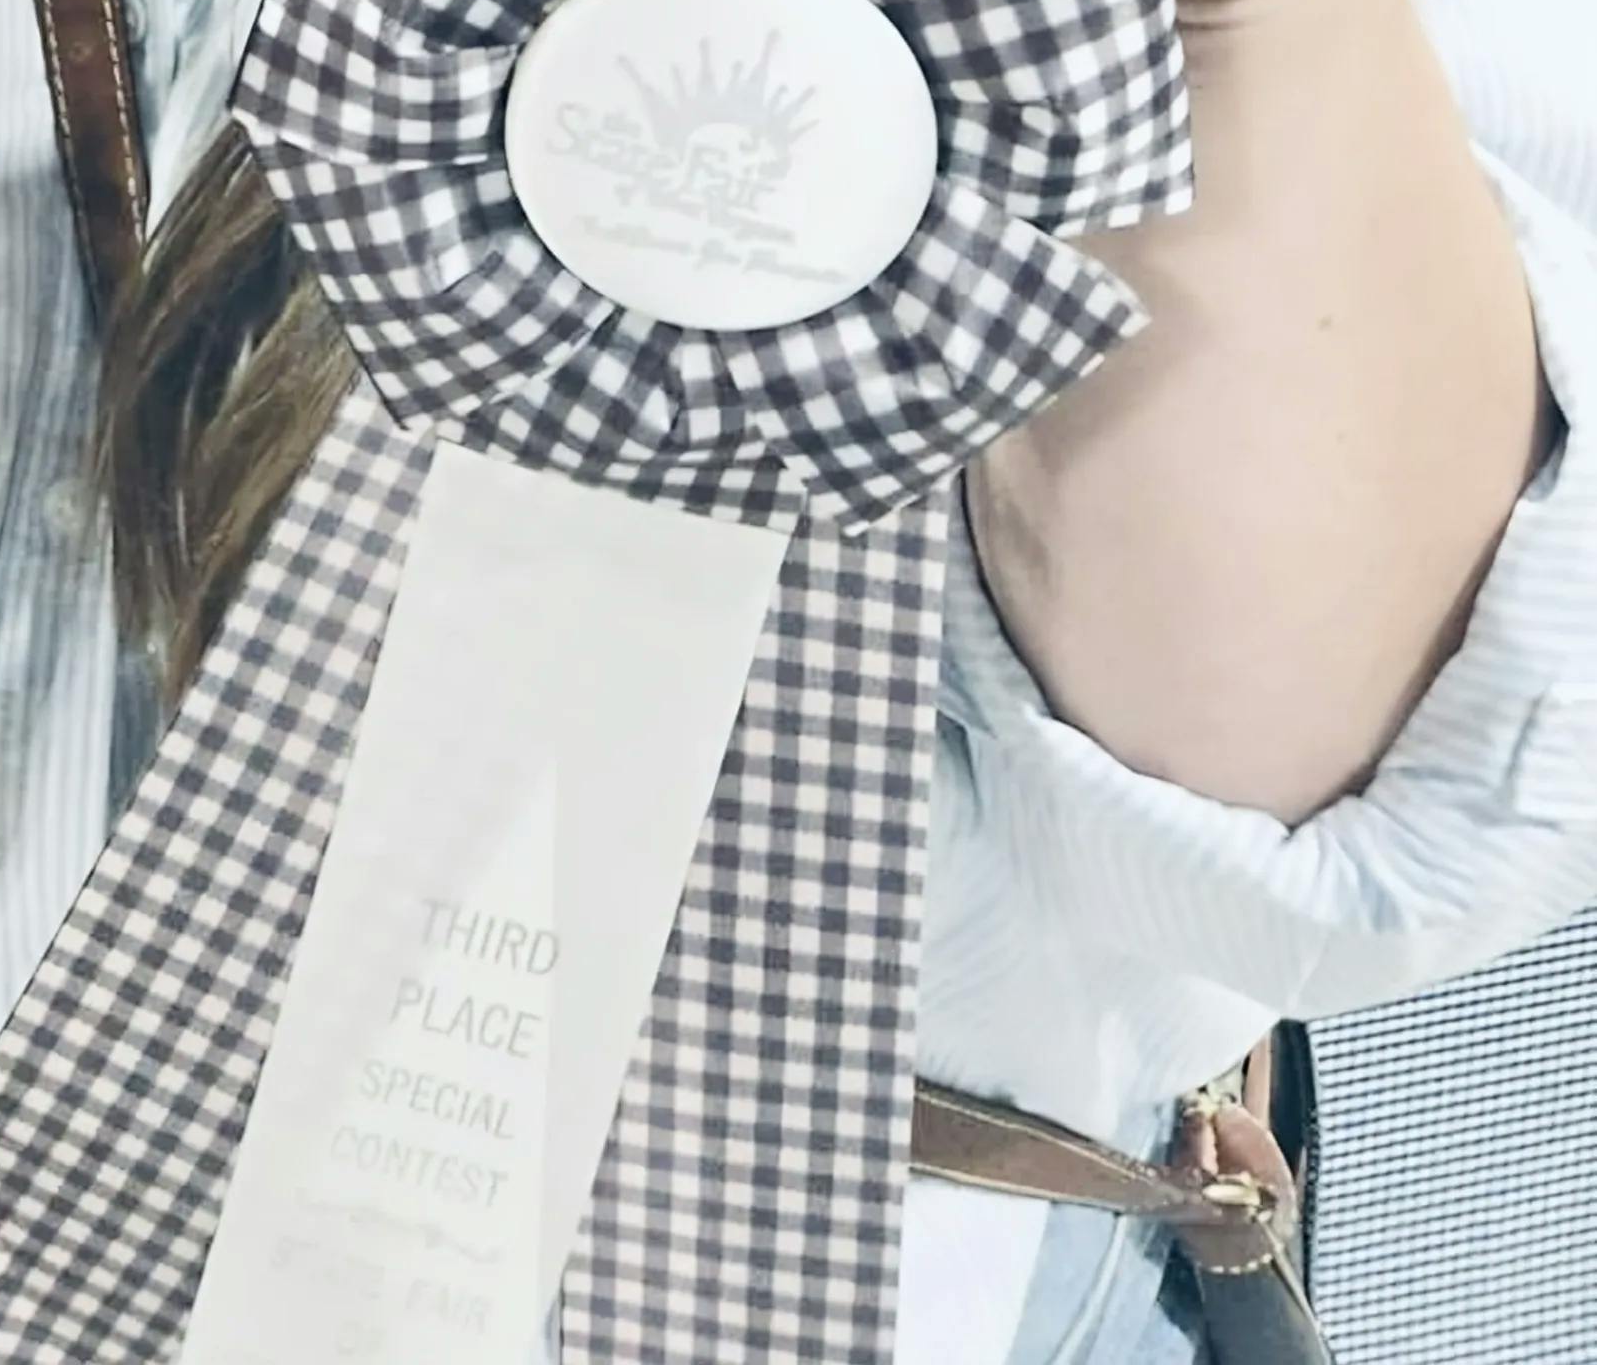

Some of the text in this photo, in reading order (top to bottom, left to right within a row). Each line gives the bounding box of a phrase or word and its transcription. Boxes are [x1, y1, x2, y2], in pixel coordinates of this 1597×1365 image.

[419, 898, 561, 976] THIRD
[389, 976, 543, 1059] PLACE
[360, 1058, 515, 1140] SPECIAL
[330, 1126, 510, 1209] CONTEST
